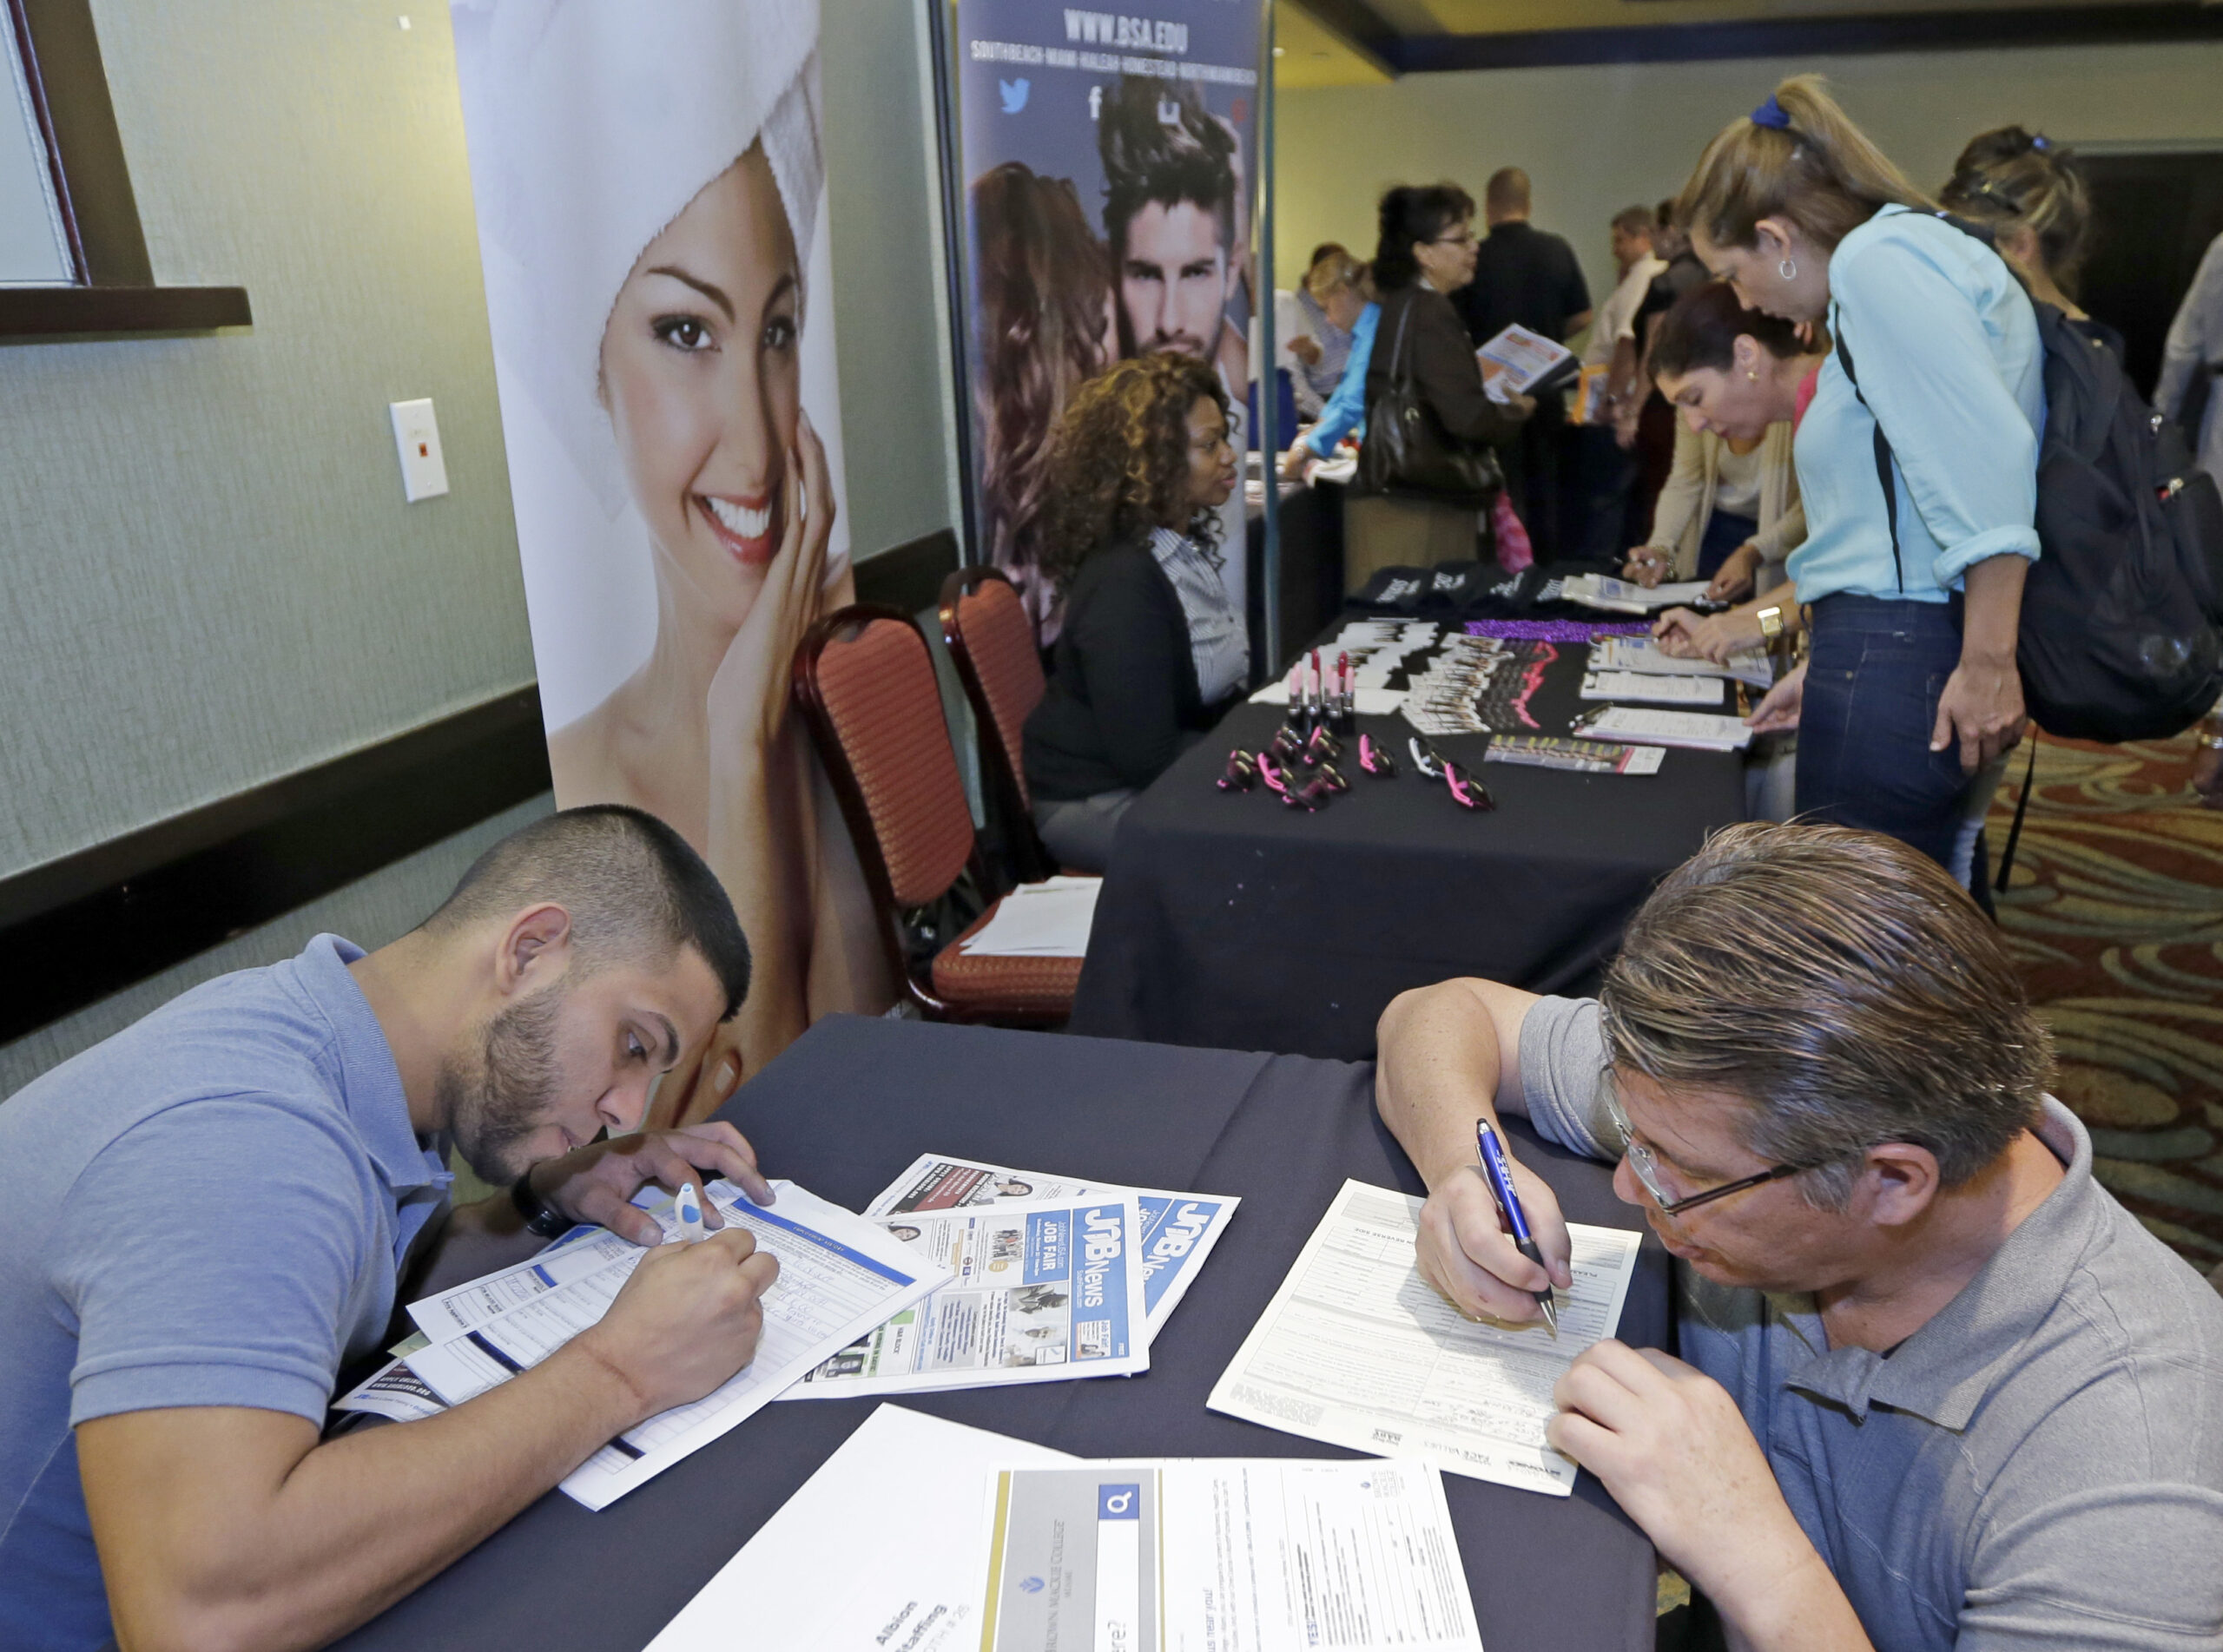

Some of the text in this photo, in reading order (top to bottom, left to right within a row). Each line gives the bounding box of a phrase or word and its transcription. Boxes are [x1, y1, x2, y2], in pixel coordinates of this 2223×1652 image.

[1043, 1221, 1057, 1270] JOB FAIR
[1051, 1519, 1065, 1564] COLLEGE
[1049, 1566, 1062, 1609] MACKIE
[1203, 1587, 1217, 1612] you!
[875, 1601, 918, 1646] Albion
[1206, 1614, 1215, 1637] near
